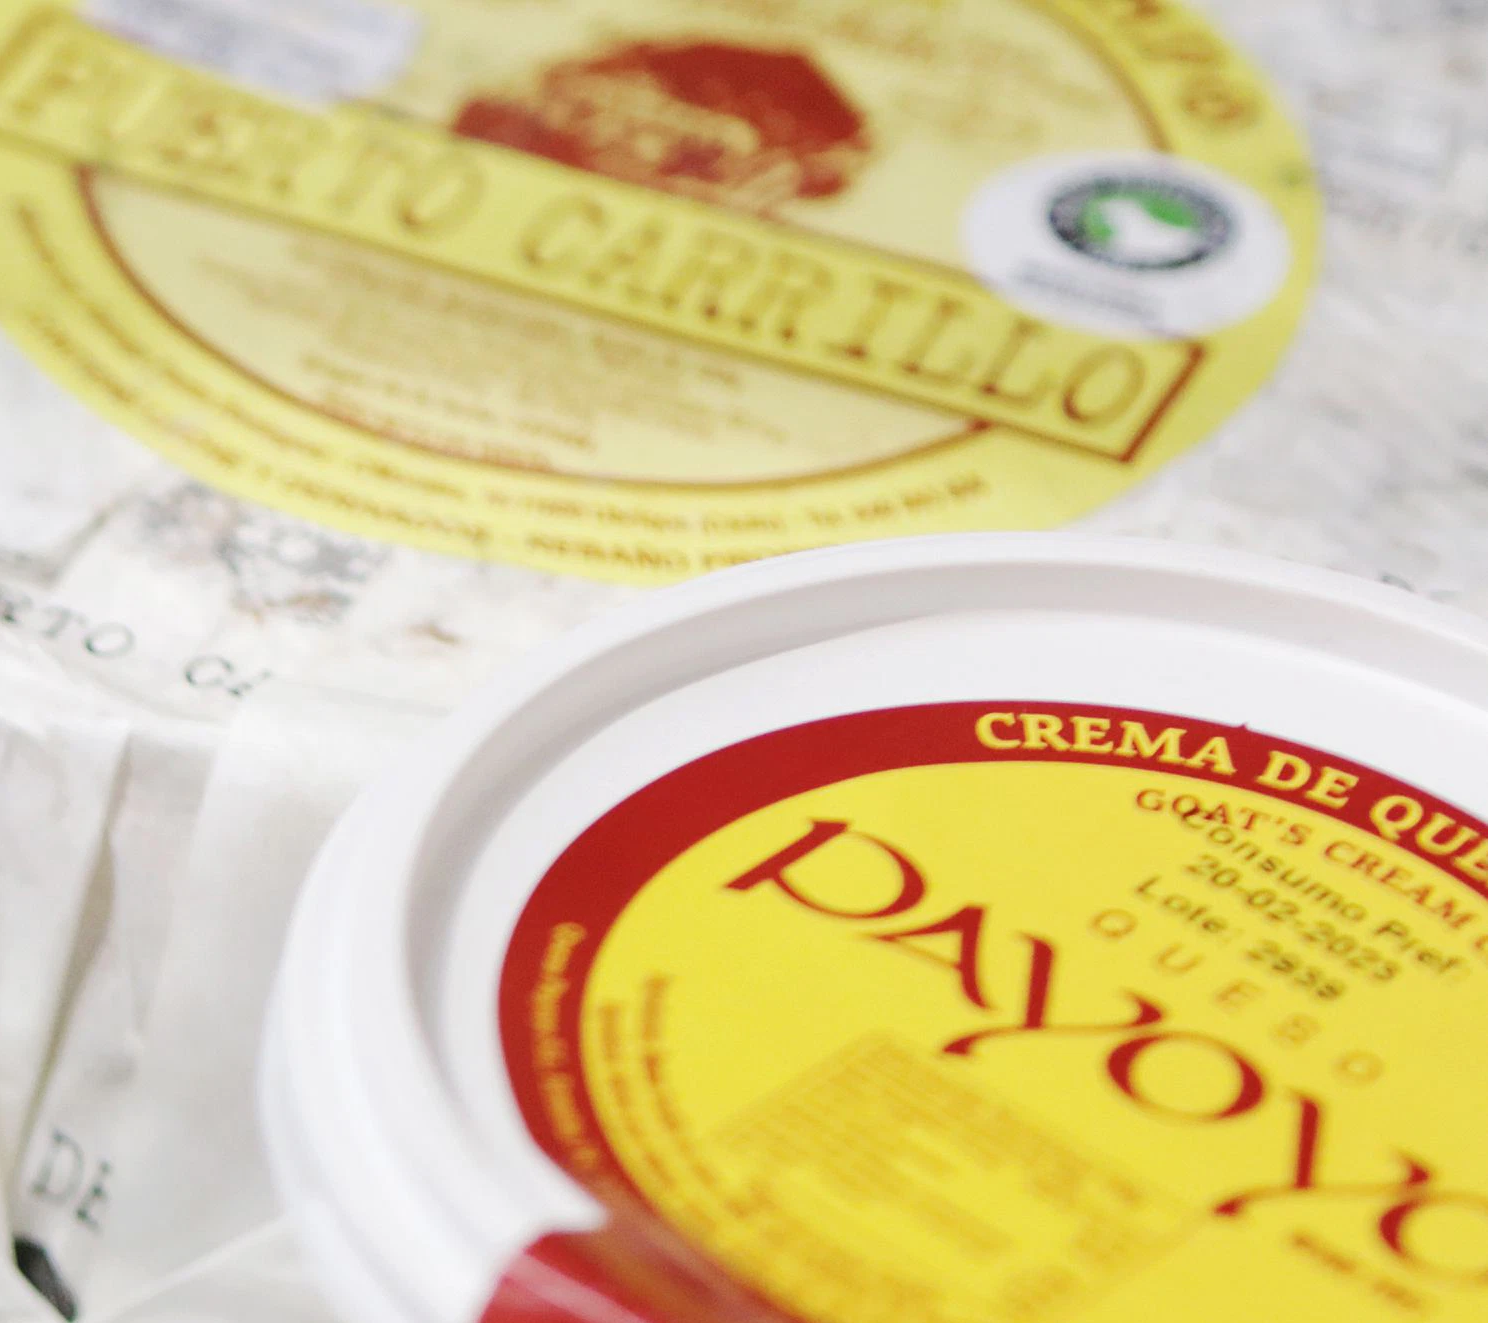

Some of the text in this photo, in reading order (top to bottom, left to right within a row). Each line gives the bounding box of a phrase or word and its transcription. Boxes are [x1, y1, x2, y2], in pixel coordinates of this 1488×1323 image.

[519, 193, 1147, 426] CARRILLO
[974, 711, 1237, 774] CREMA
[1255, 750, 1360, 809] DE
[1136, 788, 1476, 930] GOAT'S CREAM
[1182, 803, 1368, 925] Consumo
